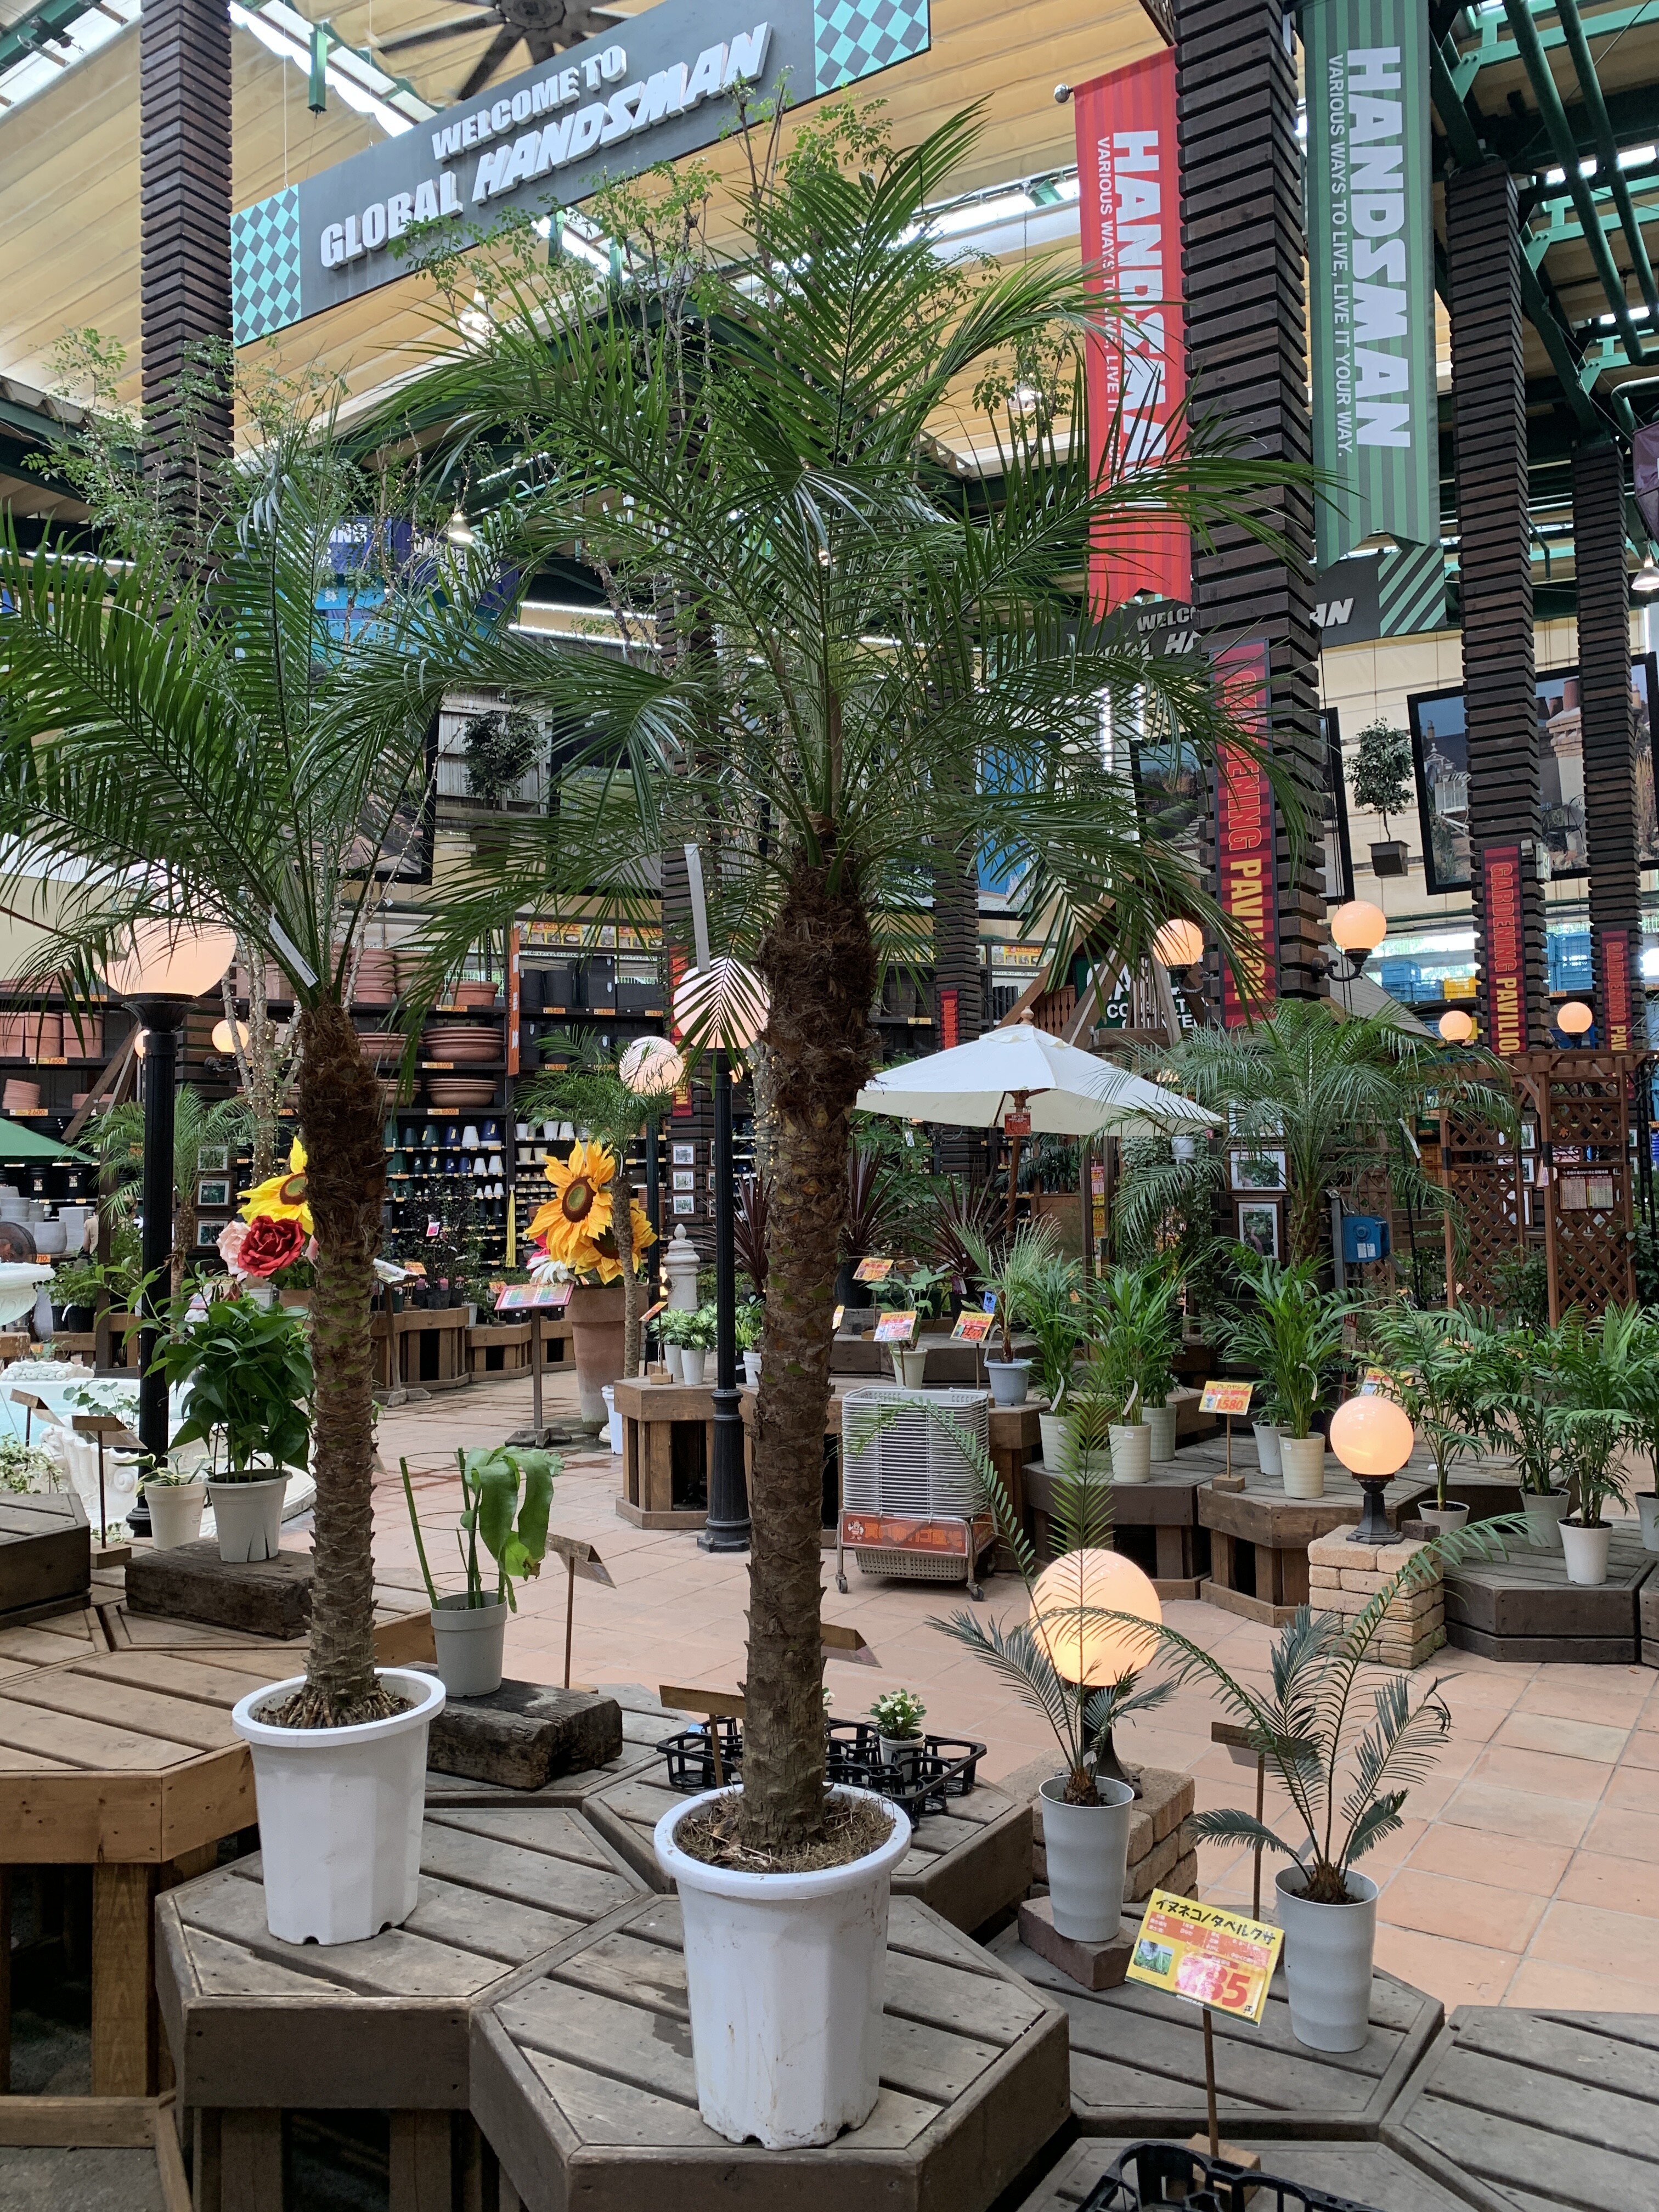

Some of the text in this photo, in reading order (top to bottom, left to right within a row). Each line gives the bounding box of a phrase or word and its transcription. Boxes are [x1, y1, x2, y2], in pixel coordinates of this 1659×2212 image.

[320, 22, 772, 269] GLOBAL HANDSMAN
[432, 44, 627, 161] WELCOME TO
[1097, 136, 1113, 216] VARIOUS
[1101, 220, 1116, 270] WAYS
[1329, 54, 1353, 457] VARIOUS WAYS TO LIVE, LIVE IT YOUR WAY.
[1347, 46, 1411, 448] HANDSMAN
[1106, 356, 1119, 393] LIVE
[1489, 862, 1521, 1056] GARDENING PAVILIO
[1606, 941, 1627, 1022] GARDENING
